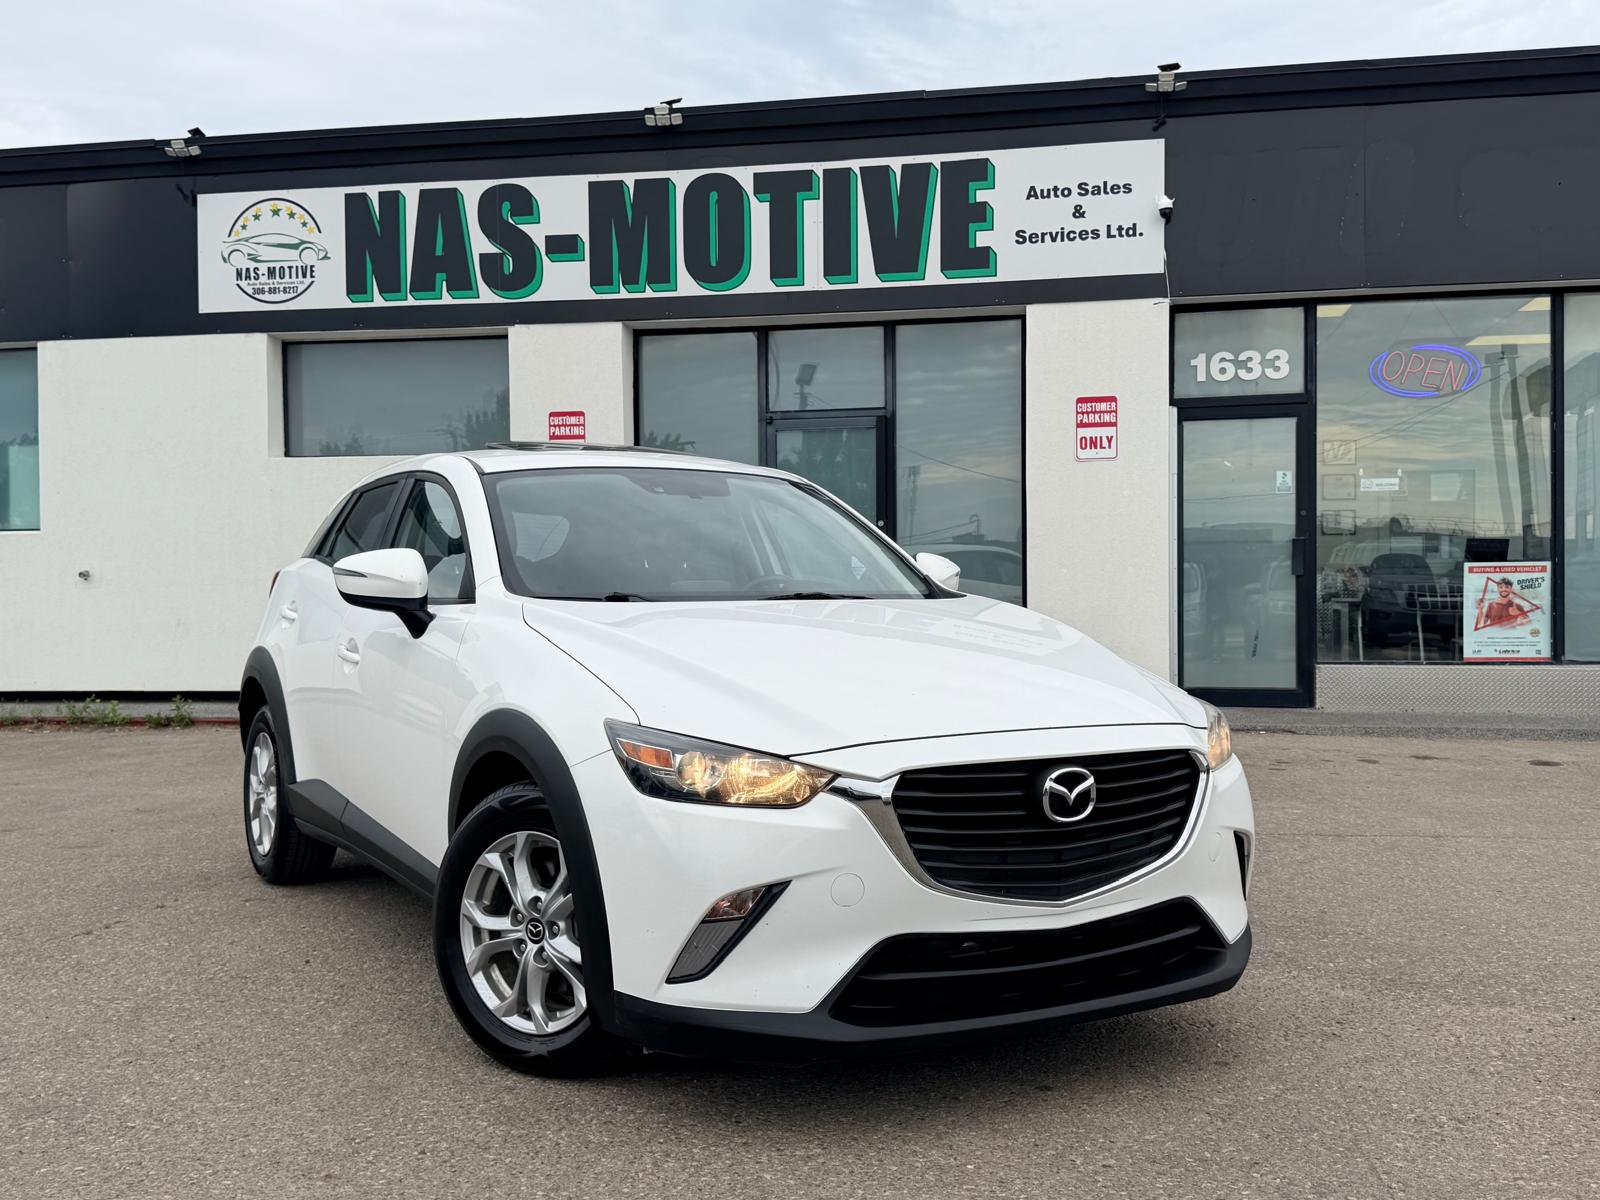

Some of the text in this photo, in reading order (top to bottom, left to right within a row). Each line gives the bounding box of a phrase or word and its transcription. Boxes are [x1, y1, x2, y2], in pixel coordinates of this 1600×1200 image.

[1026, 181, 1133, 200] Auto Sales
[1072, 204, 1087, 219] &
[344, 157, 998, 303] NAS-MOTIVE
[1015, 222, 1144, 245] Services Ltd.
[236, 265, 315, 281] NAS-MOTIVE
[252, 286, 299, 295] 306-881-8217
[1190, 348, 1290, 382] 1633
[1383, 351, 1465, 391] OPEN
[1077, 402, 1116, 412] CUSTOMER
[550, 416, 584, 425] CUSTOMER
[1077, 412, 1116, 423] PARKING
[550, 426, 584, 436] PARKING
[1080, 435, 1114, 450] ONLY
